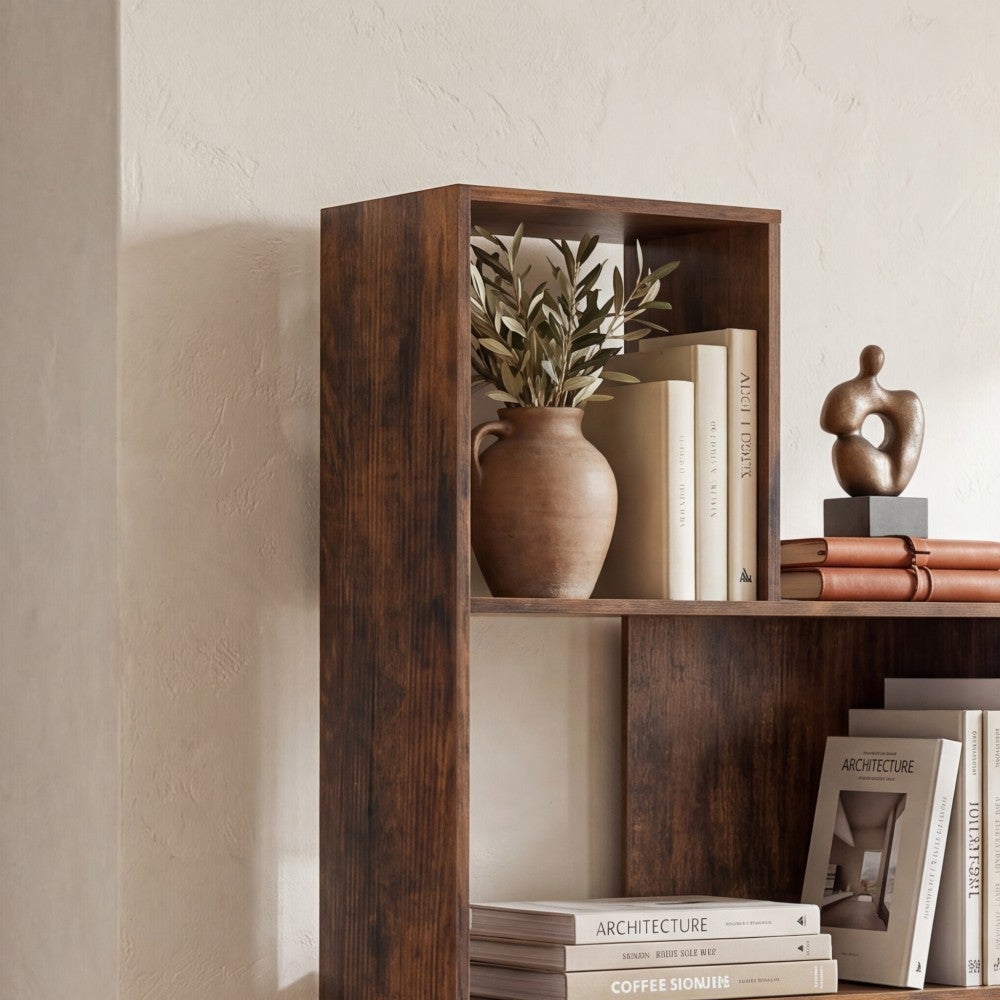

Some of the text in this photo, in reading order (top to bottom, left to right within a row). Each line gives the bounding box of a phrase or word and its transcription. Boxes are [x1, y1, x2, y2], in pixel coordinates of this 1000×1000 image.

[841, 757, 915, 774] ARCHITECTURE
[596, 917, 709, 937] ARCHITECTURE
[611, 978, 667, 994] COFFEE
